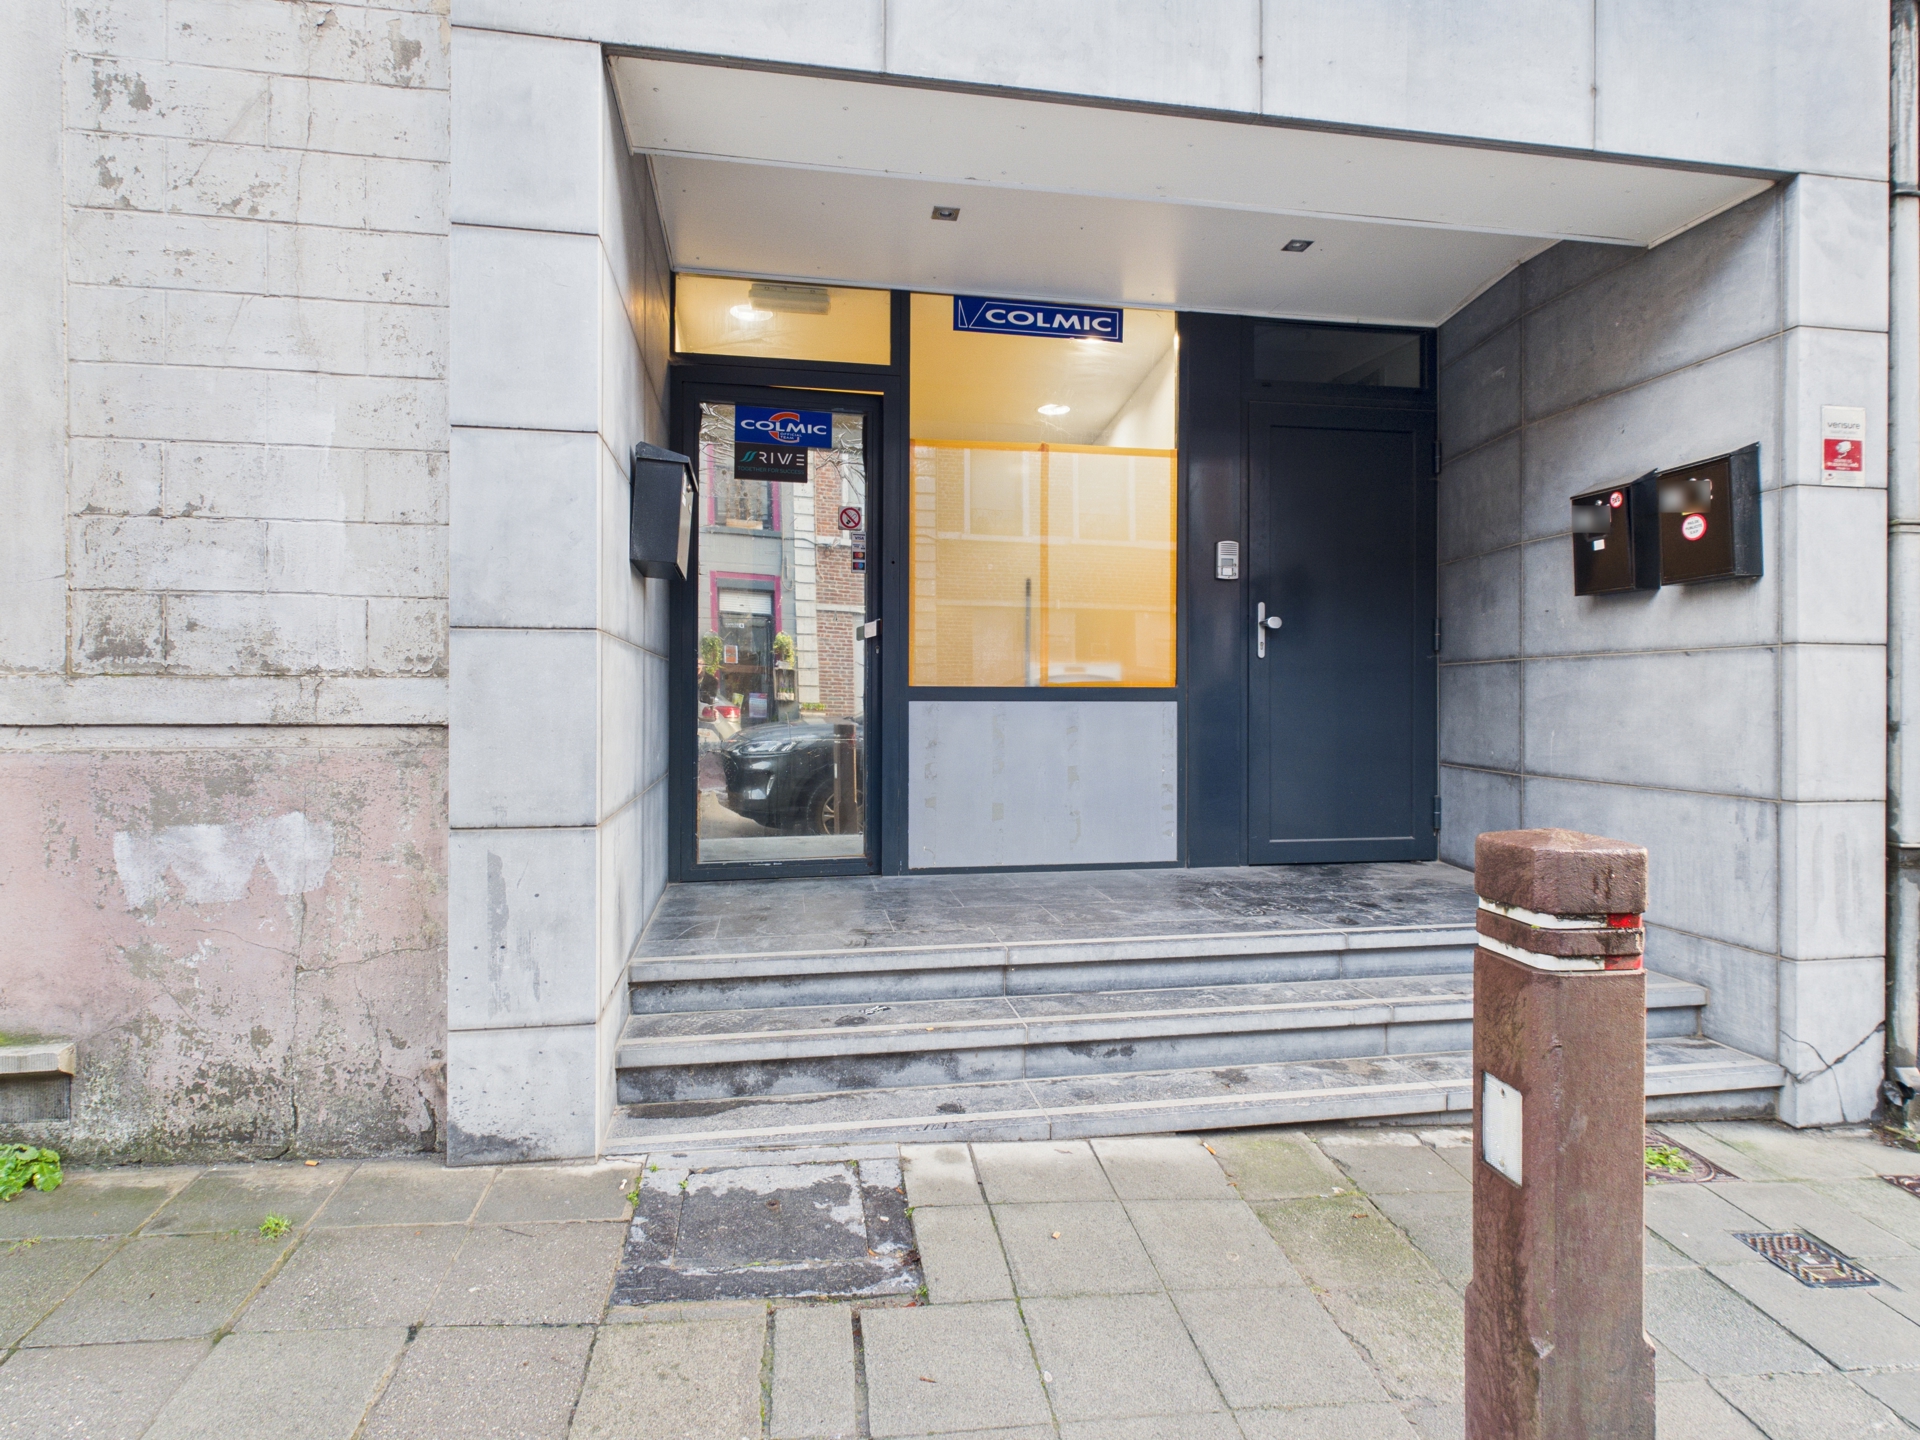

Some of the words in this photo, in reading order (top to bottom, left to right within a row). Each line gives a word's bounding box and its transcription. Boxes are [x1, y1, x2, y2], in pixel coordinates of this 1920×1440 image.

[985, 309, 1112, 332] COLMIC
[740, 419, 827, 435] COLMIC
[737, 465, 767, 473] TOGETHER
